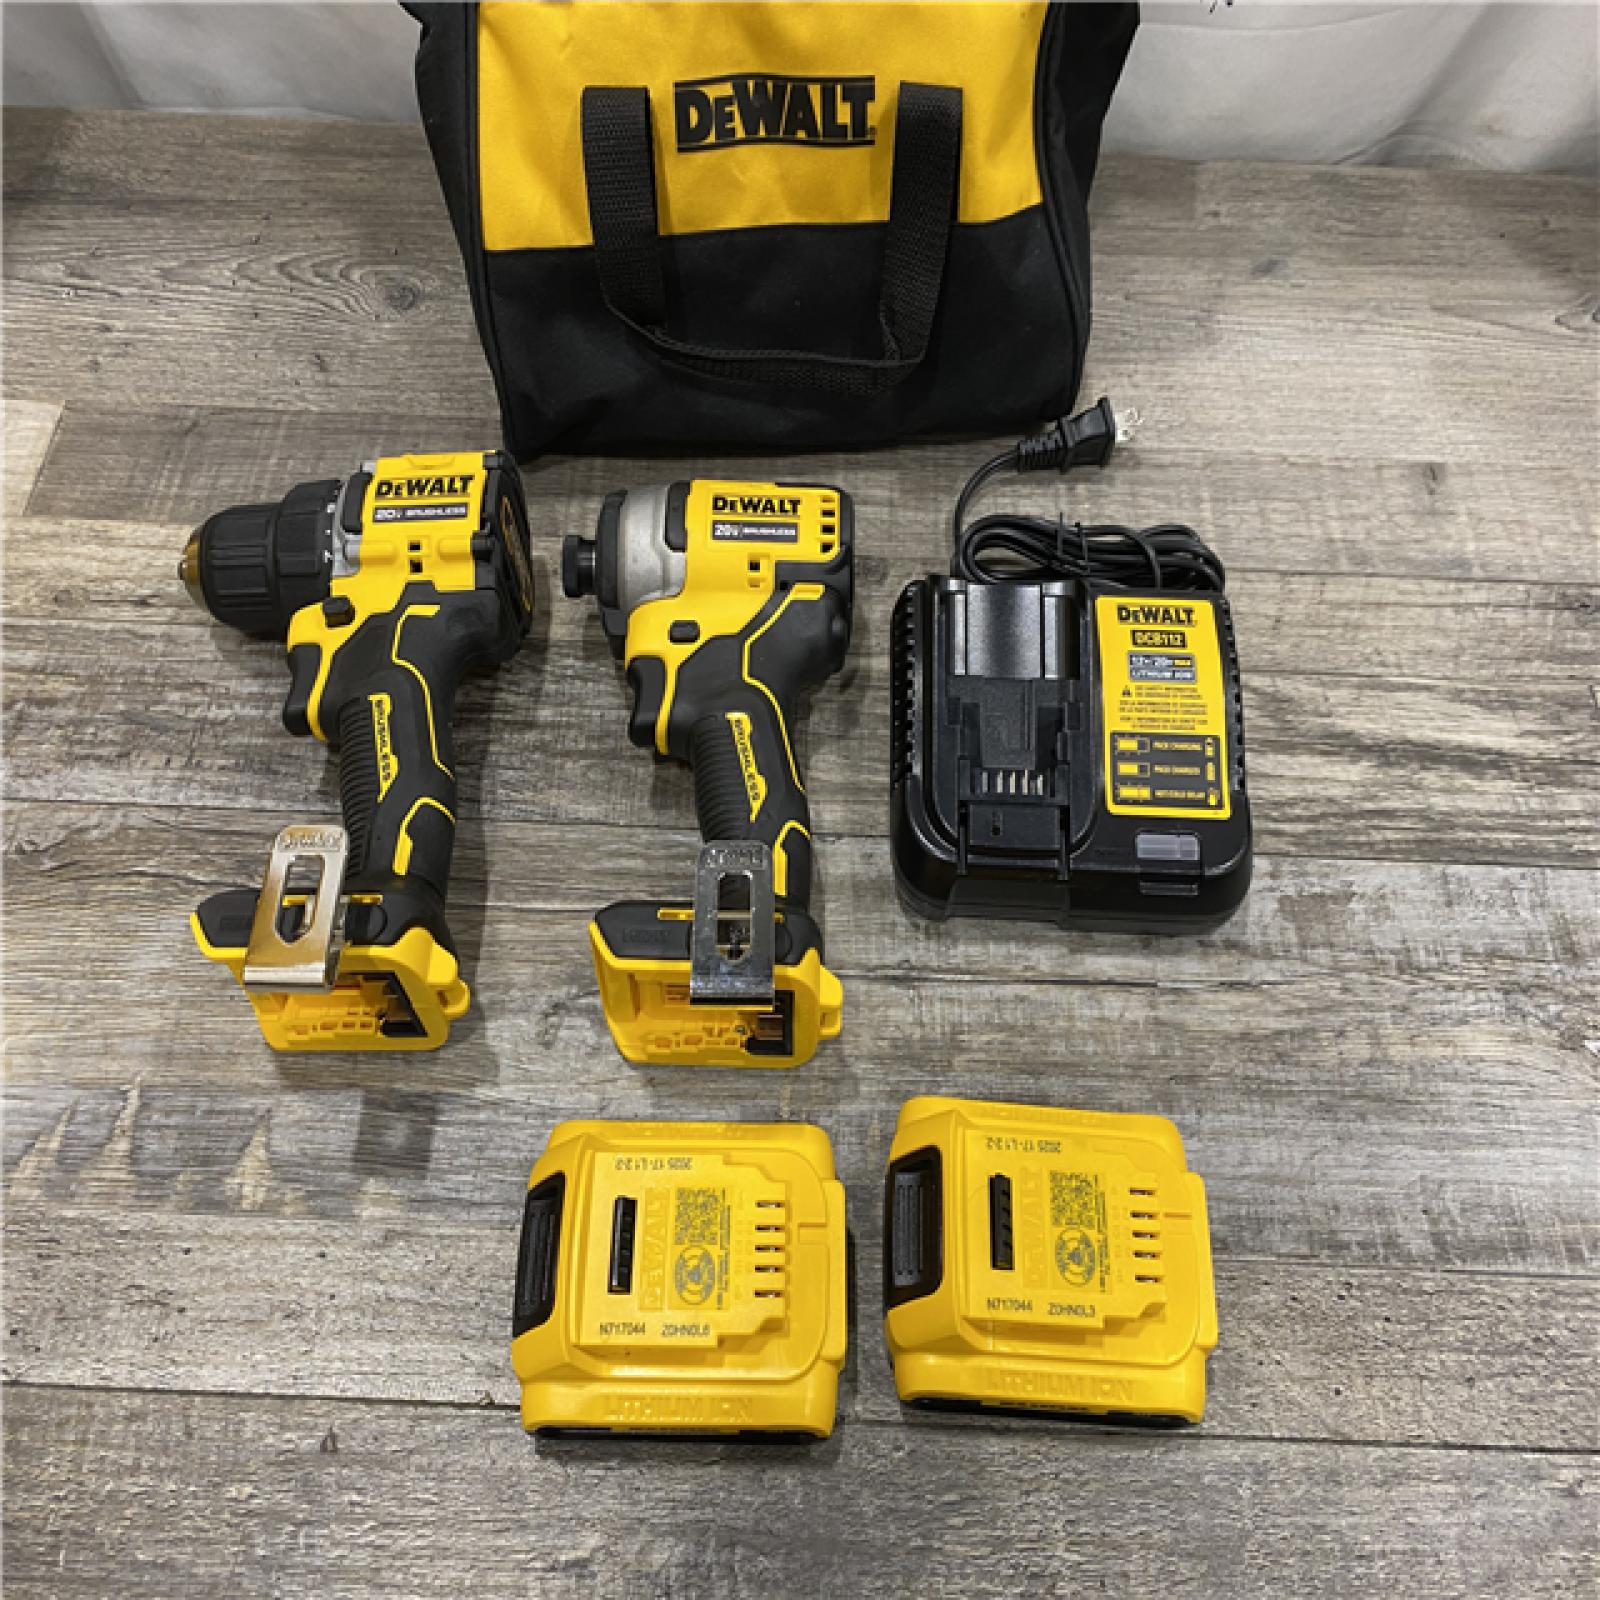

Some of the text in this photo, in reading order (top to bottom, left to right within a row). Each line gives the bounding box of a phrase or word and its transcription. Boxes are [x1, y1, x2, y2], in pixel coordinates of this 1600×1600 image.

[674, 75, 876, 151] DEWALT
[375, 475, 475, 499] DEWALT
[711, 495, 801, 516] DEWALT
[1117, 604, 1196, 626] DEWALT
